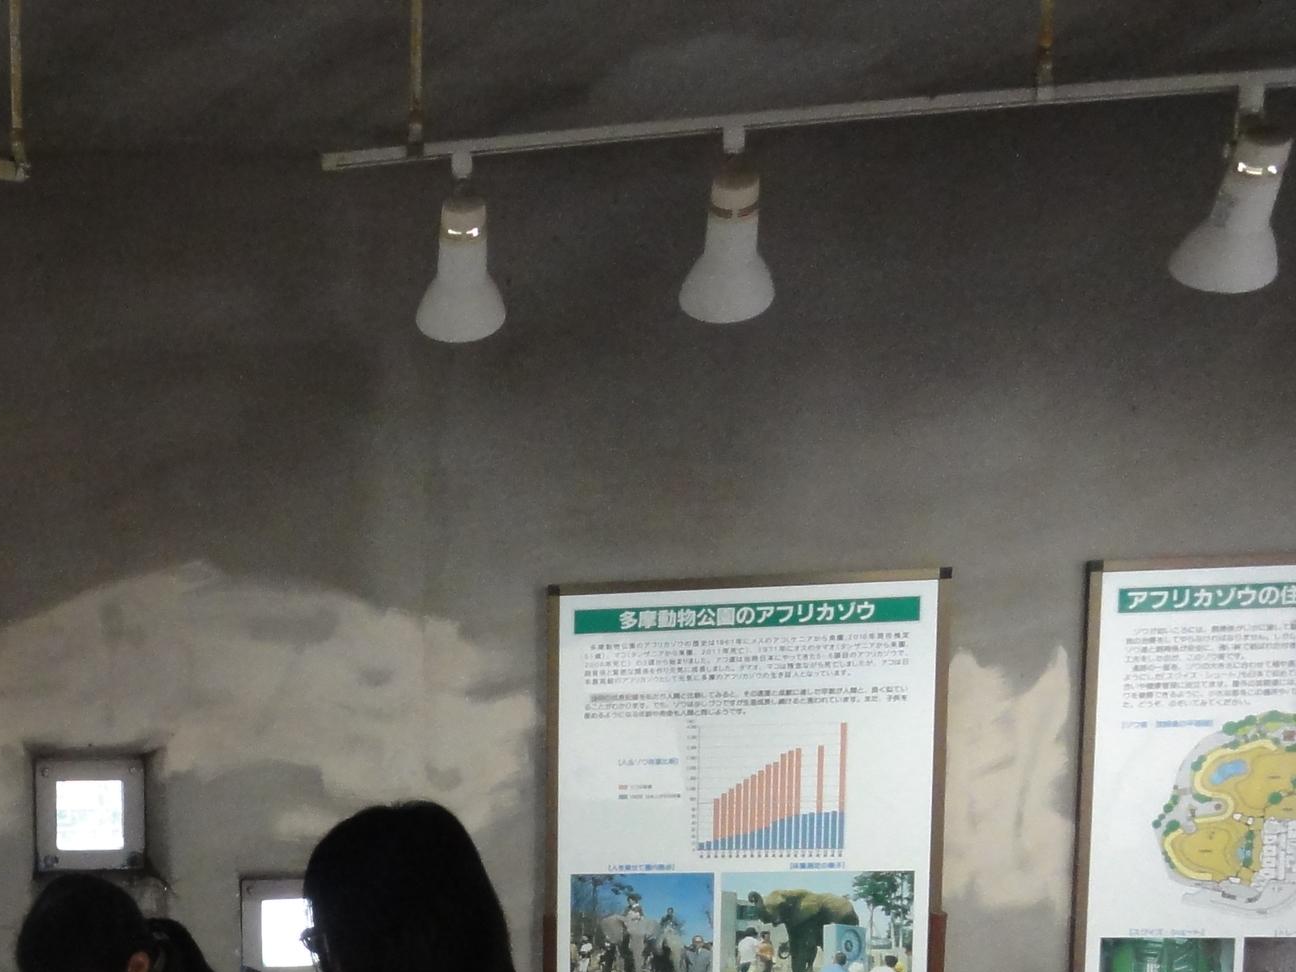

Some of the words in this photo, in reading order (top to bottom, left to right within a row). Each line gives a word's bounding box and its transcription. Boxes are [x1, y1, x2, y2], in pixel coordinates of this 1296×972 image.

[1127, 585, 1296, 610] アフリカゾウの住
[618, 601, 876, 630] 多摩動物公園のアフリカゾウ
